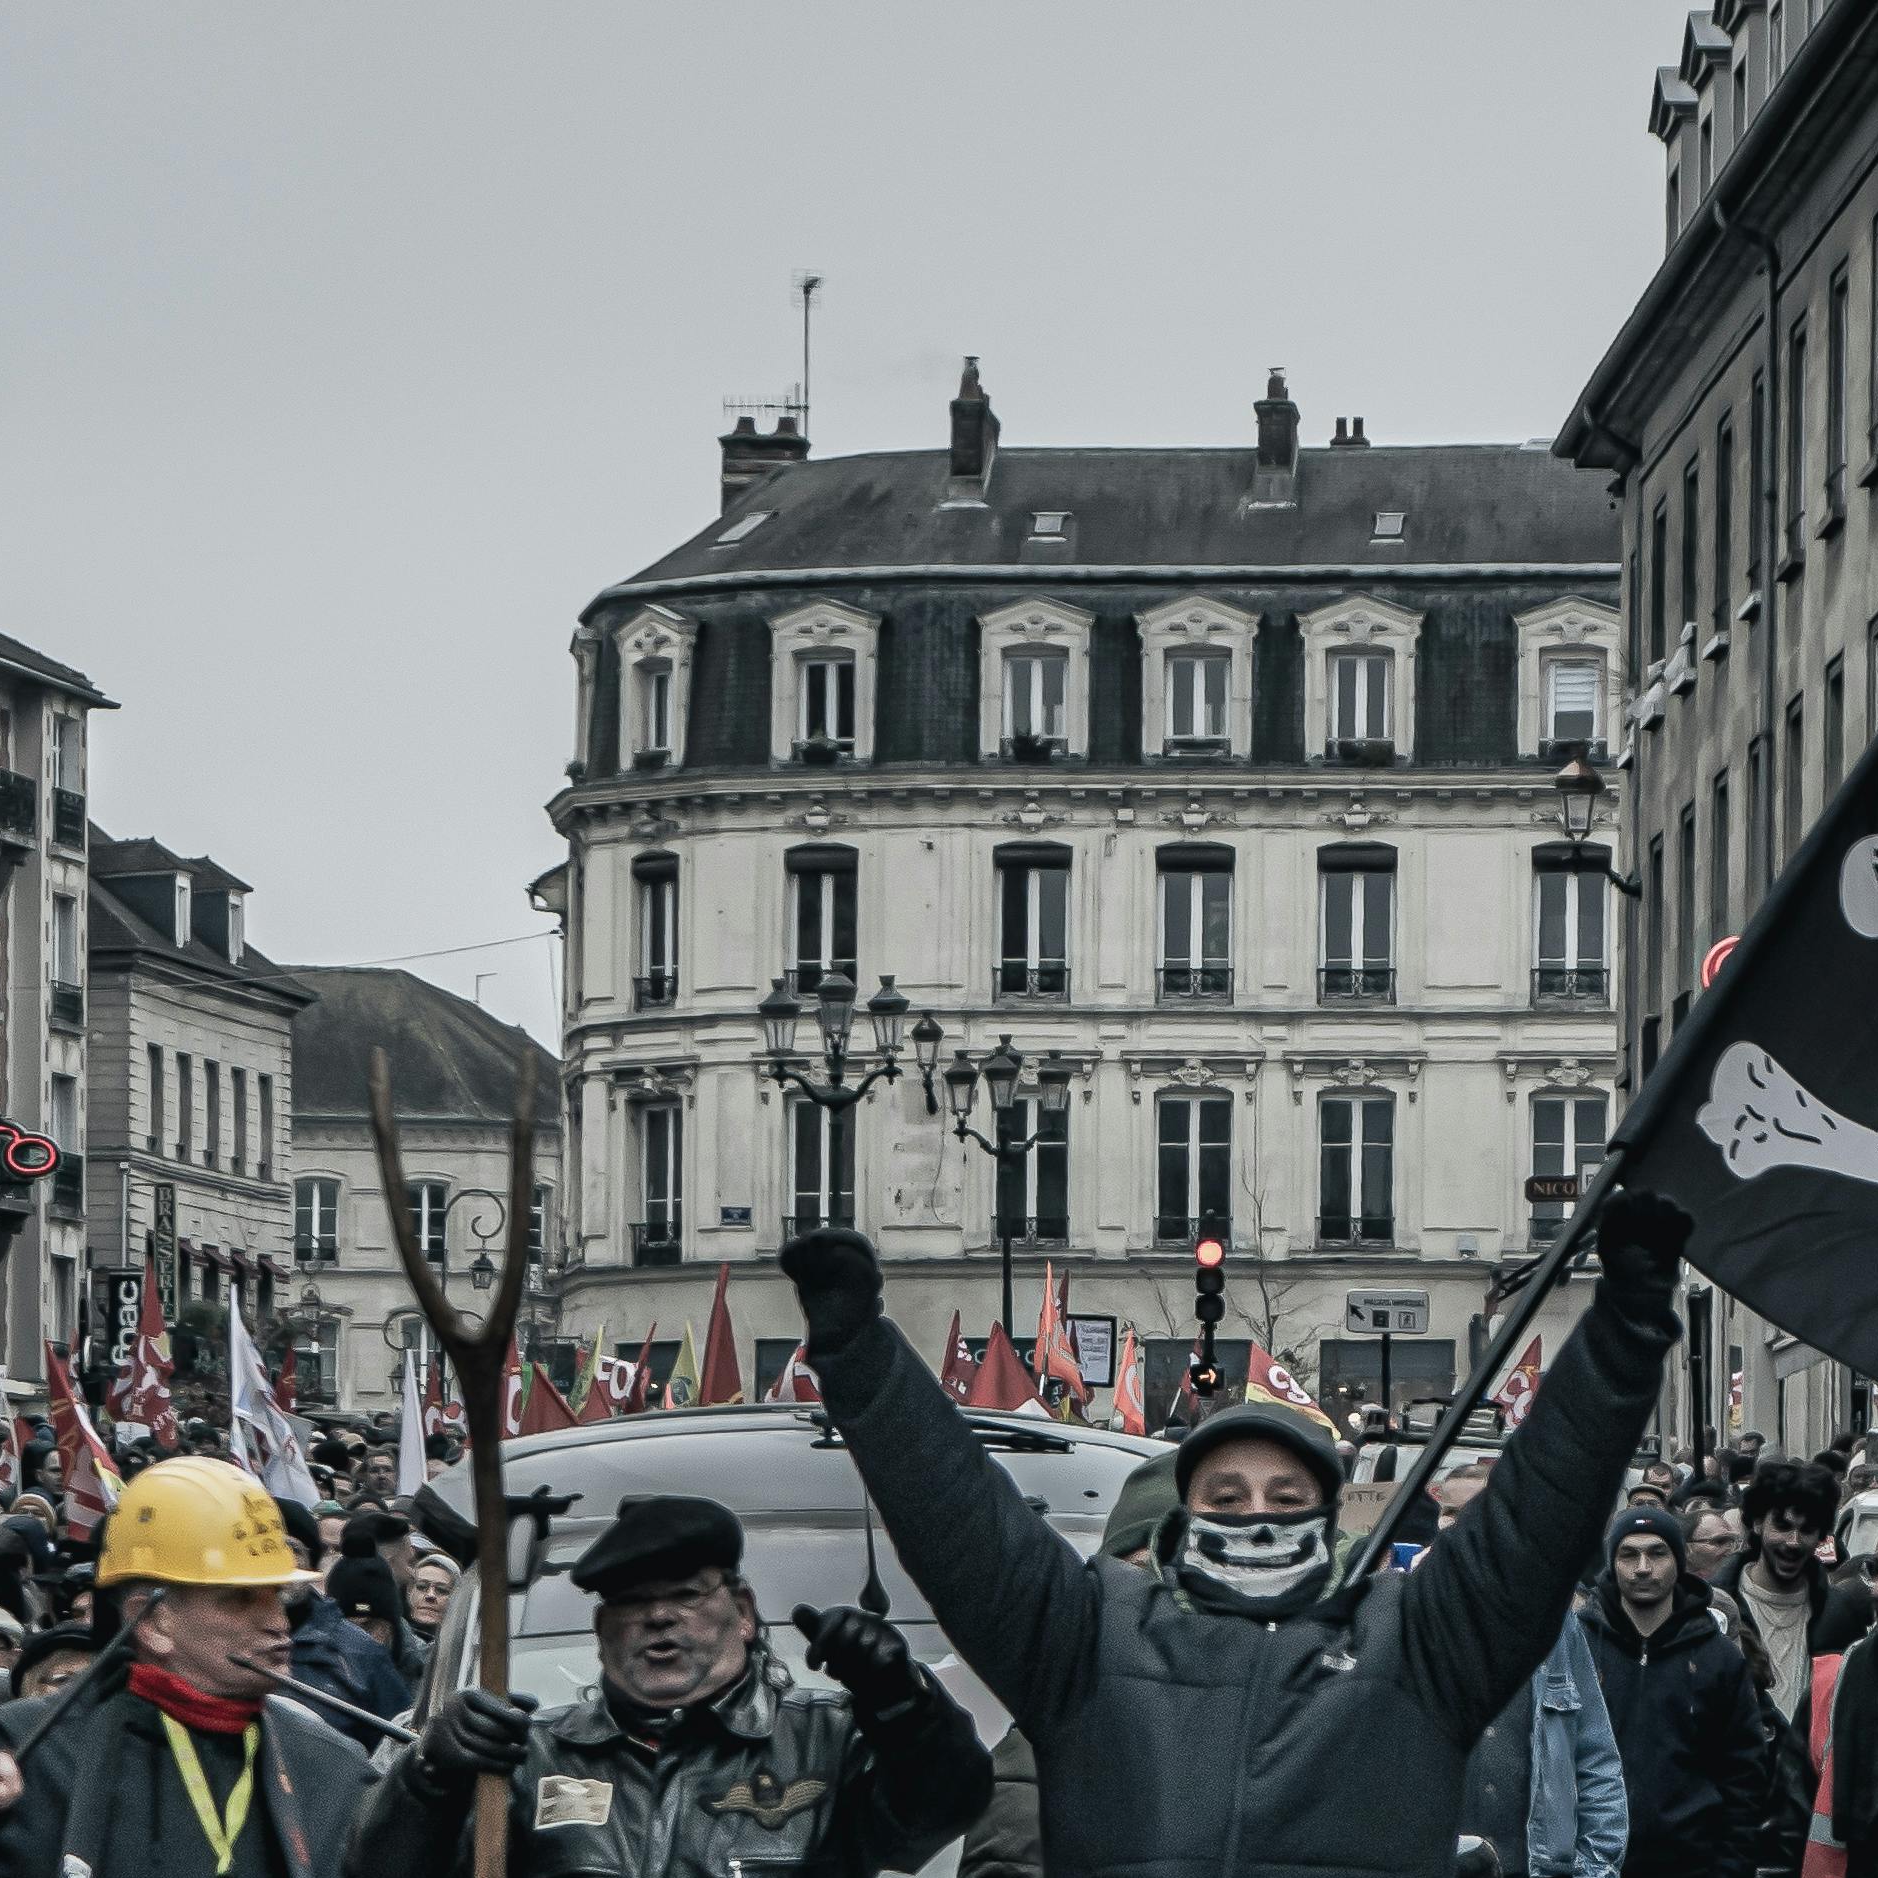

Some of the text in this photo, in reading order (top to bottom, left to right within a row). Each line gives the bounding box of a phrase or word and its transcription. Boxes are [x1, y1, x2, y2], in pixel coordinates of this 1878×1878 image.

[1533, 1181, 1576, 1196] NICO
[156, 1186, 173, 1318] BRASSERIE
[112, 1280, 140, 1366] fnac
